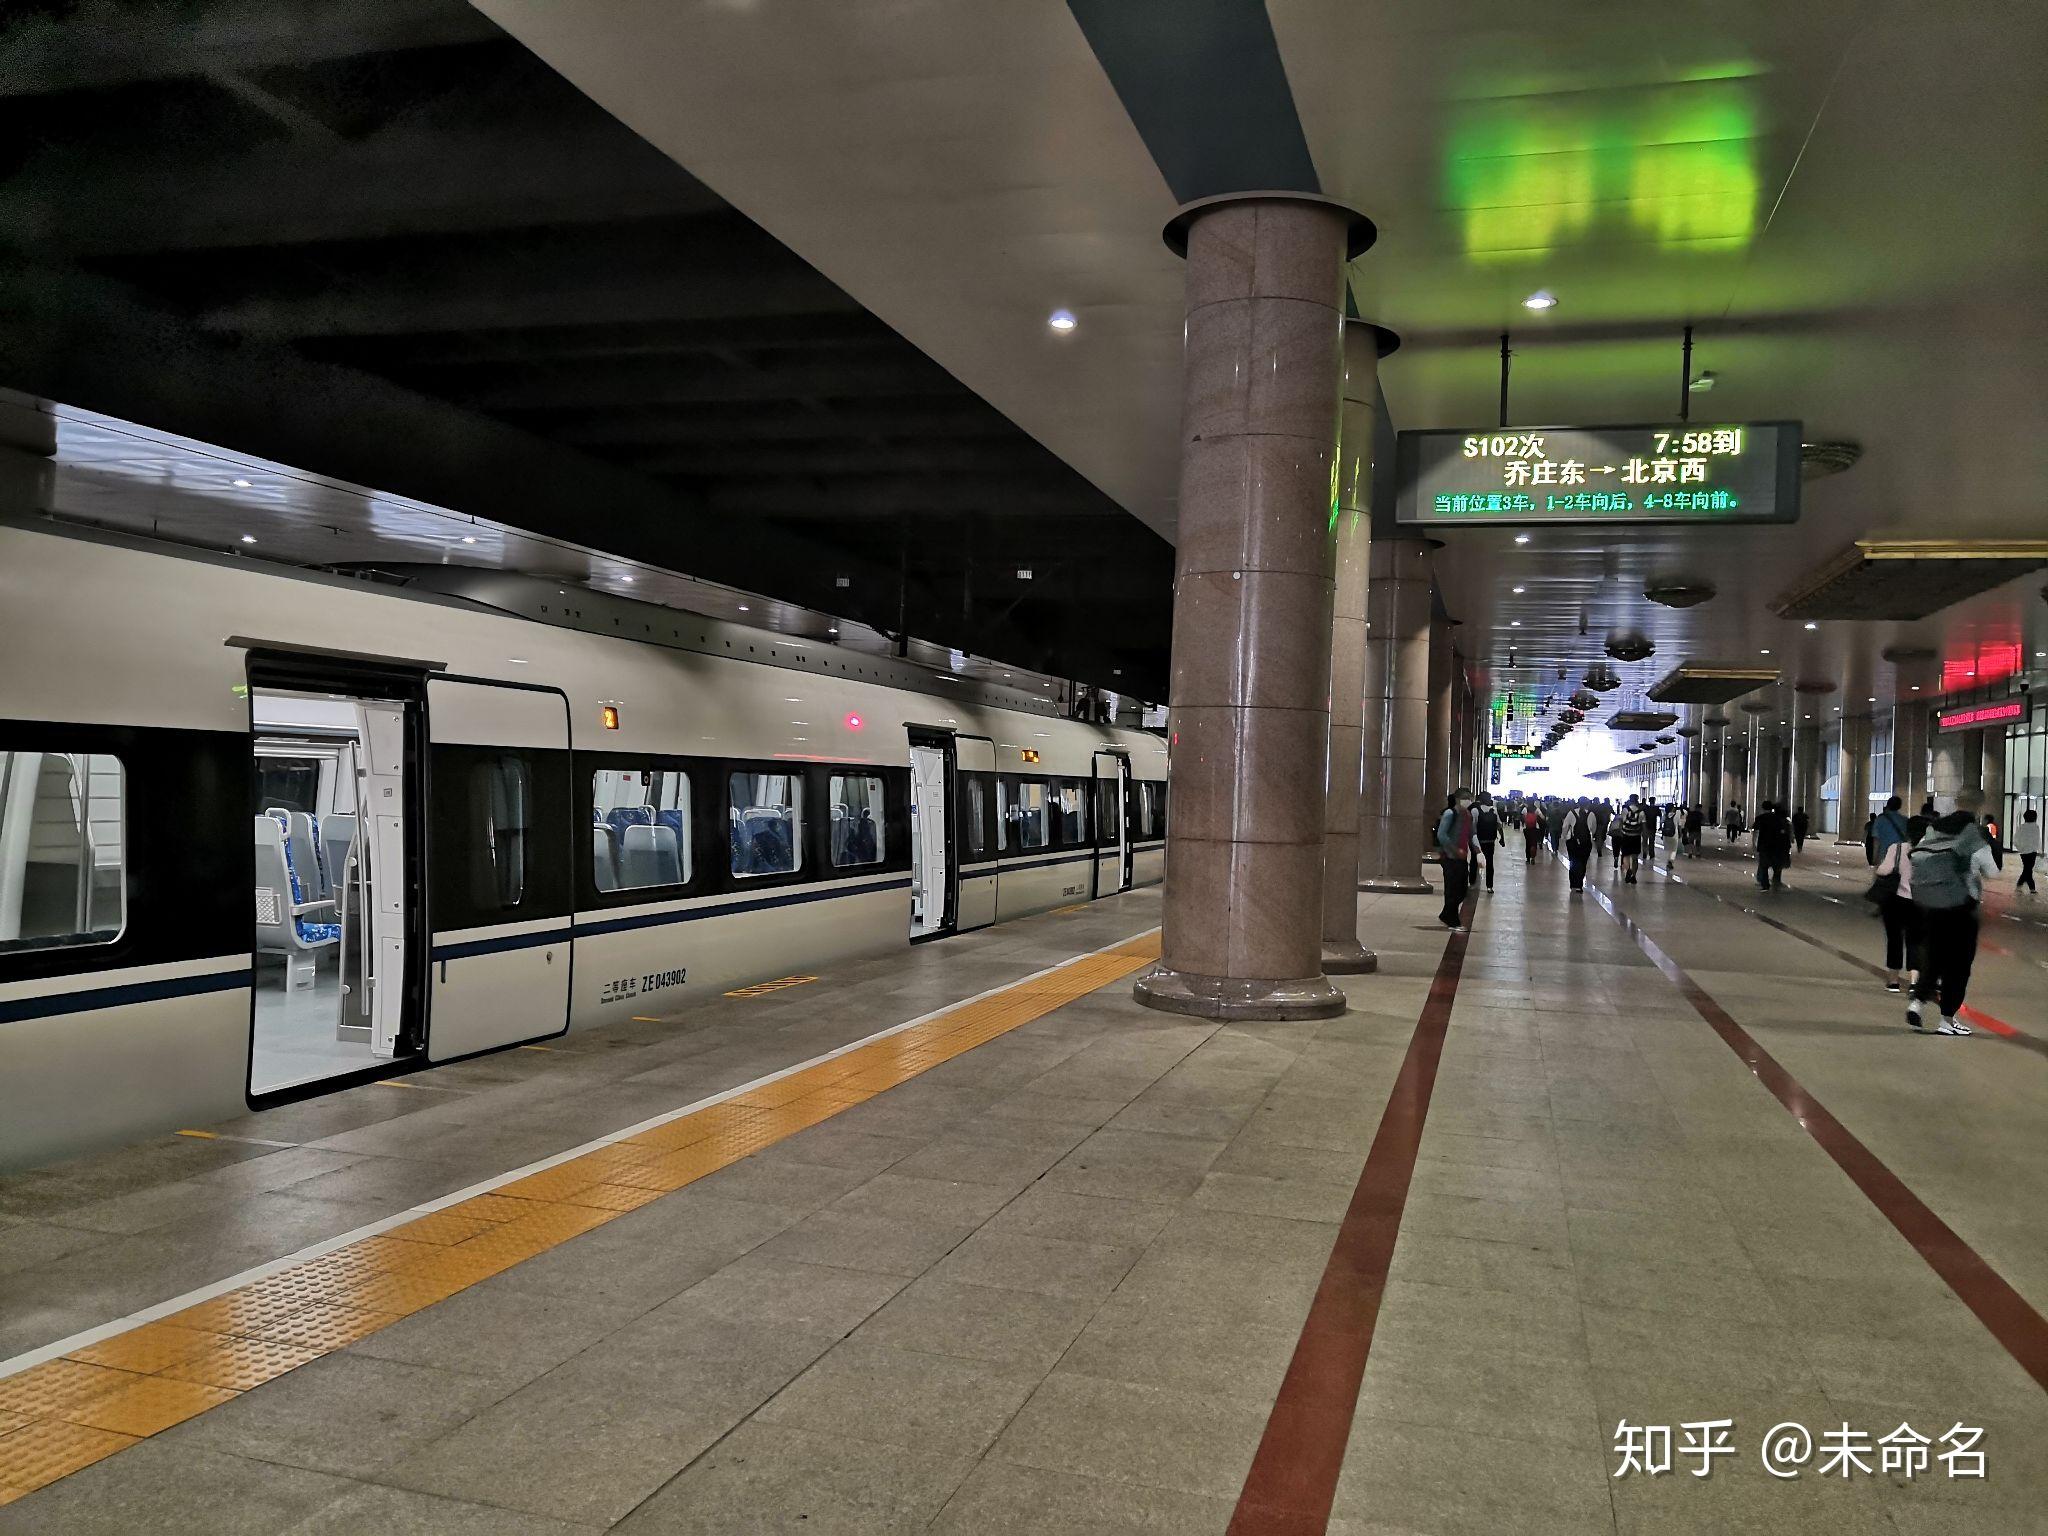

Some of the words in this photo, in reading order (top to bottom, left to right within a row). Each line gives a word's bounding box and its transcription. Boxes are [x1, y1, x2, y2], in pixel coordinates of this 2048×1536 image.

[1463, 433, 1546, 459] S102次
[1653, 428, 1741, 456] 7:58到
[1503, 459, 1586, 487] 乔庄东
[1620, 457, 1708, 484] 北京西
